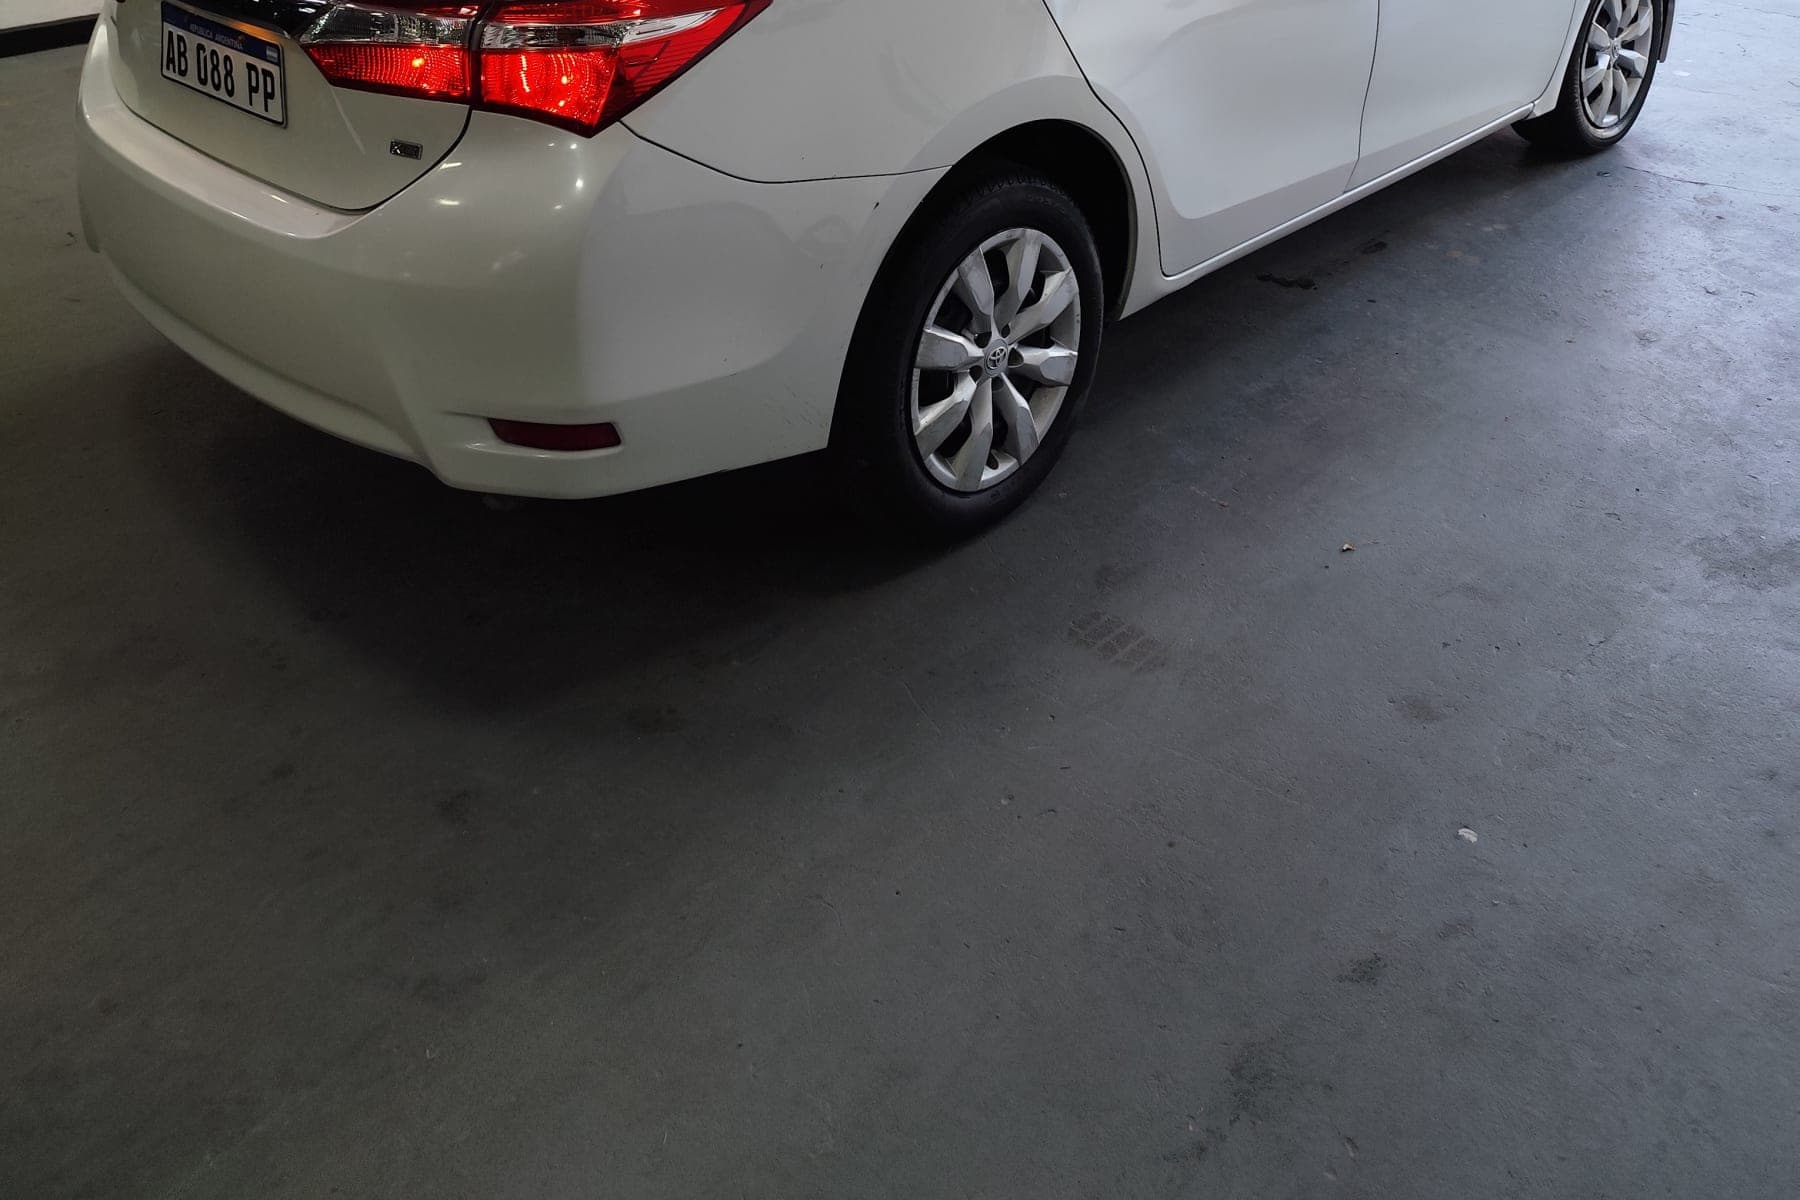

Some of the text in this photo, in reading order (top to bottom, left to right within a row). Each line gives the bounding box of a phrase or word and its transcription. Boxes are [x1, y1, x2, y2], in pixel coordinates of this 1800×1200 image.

[166, 30, 275, 113] AB 088 PP
